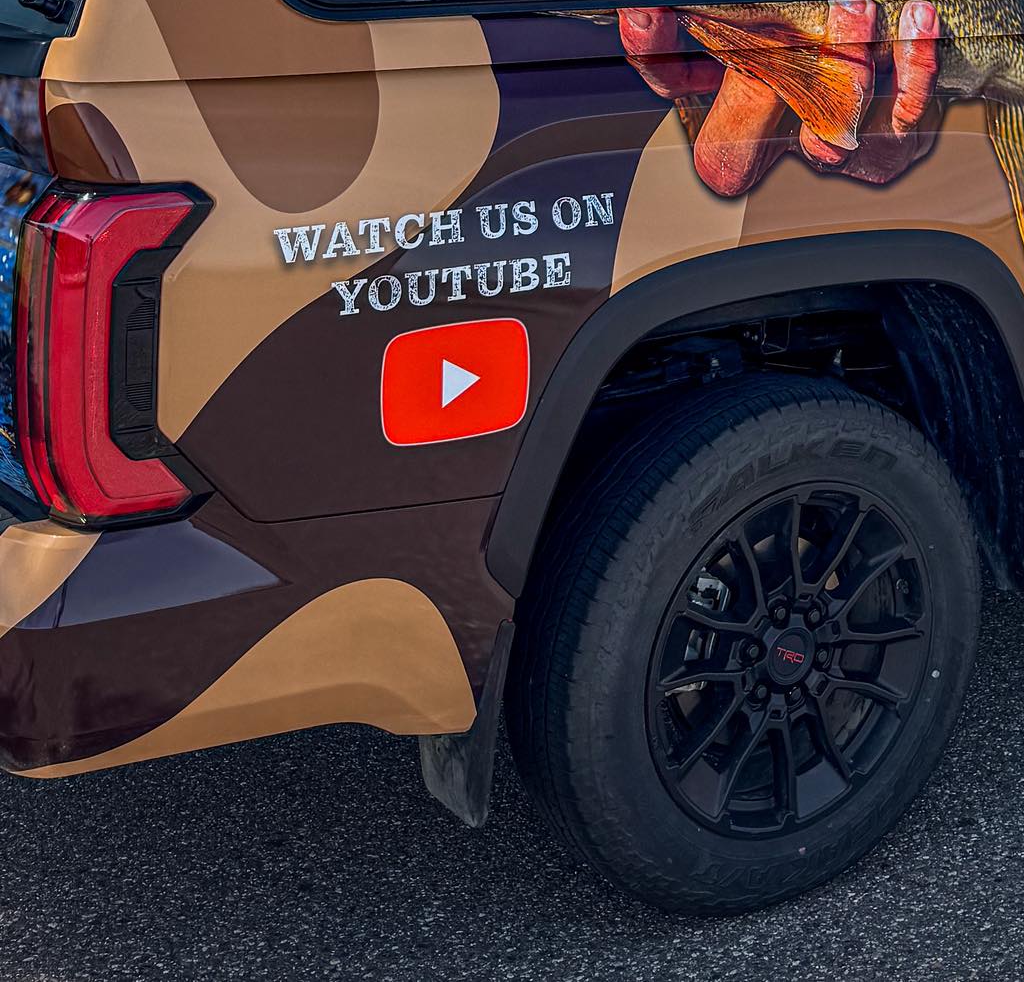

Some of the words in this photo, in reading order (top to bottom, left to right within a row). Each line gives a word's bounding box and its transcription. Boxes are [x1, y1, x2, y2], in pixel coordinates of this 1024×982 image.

[274, 208, 464, 263] WATCH
[475, 200, 539, 239] US
[552, 192, 615, 230] ON
[331, 252, 572, 316] YOUTUBE
[776, 646, 805, 664] TRD
